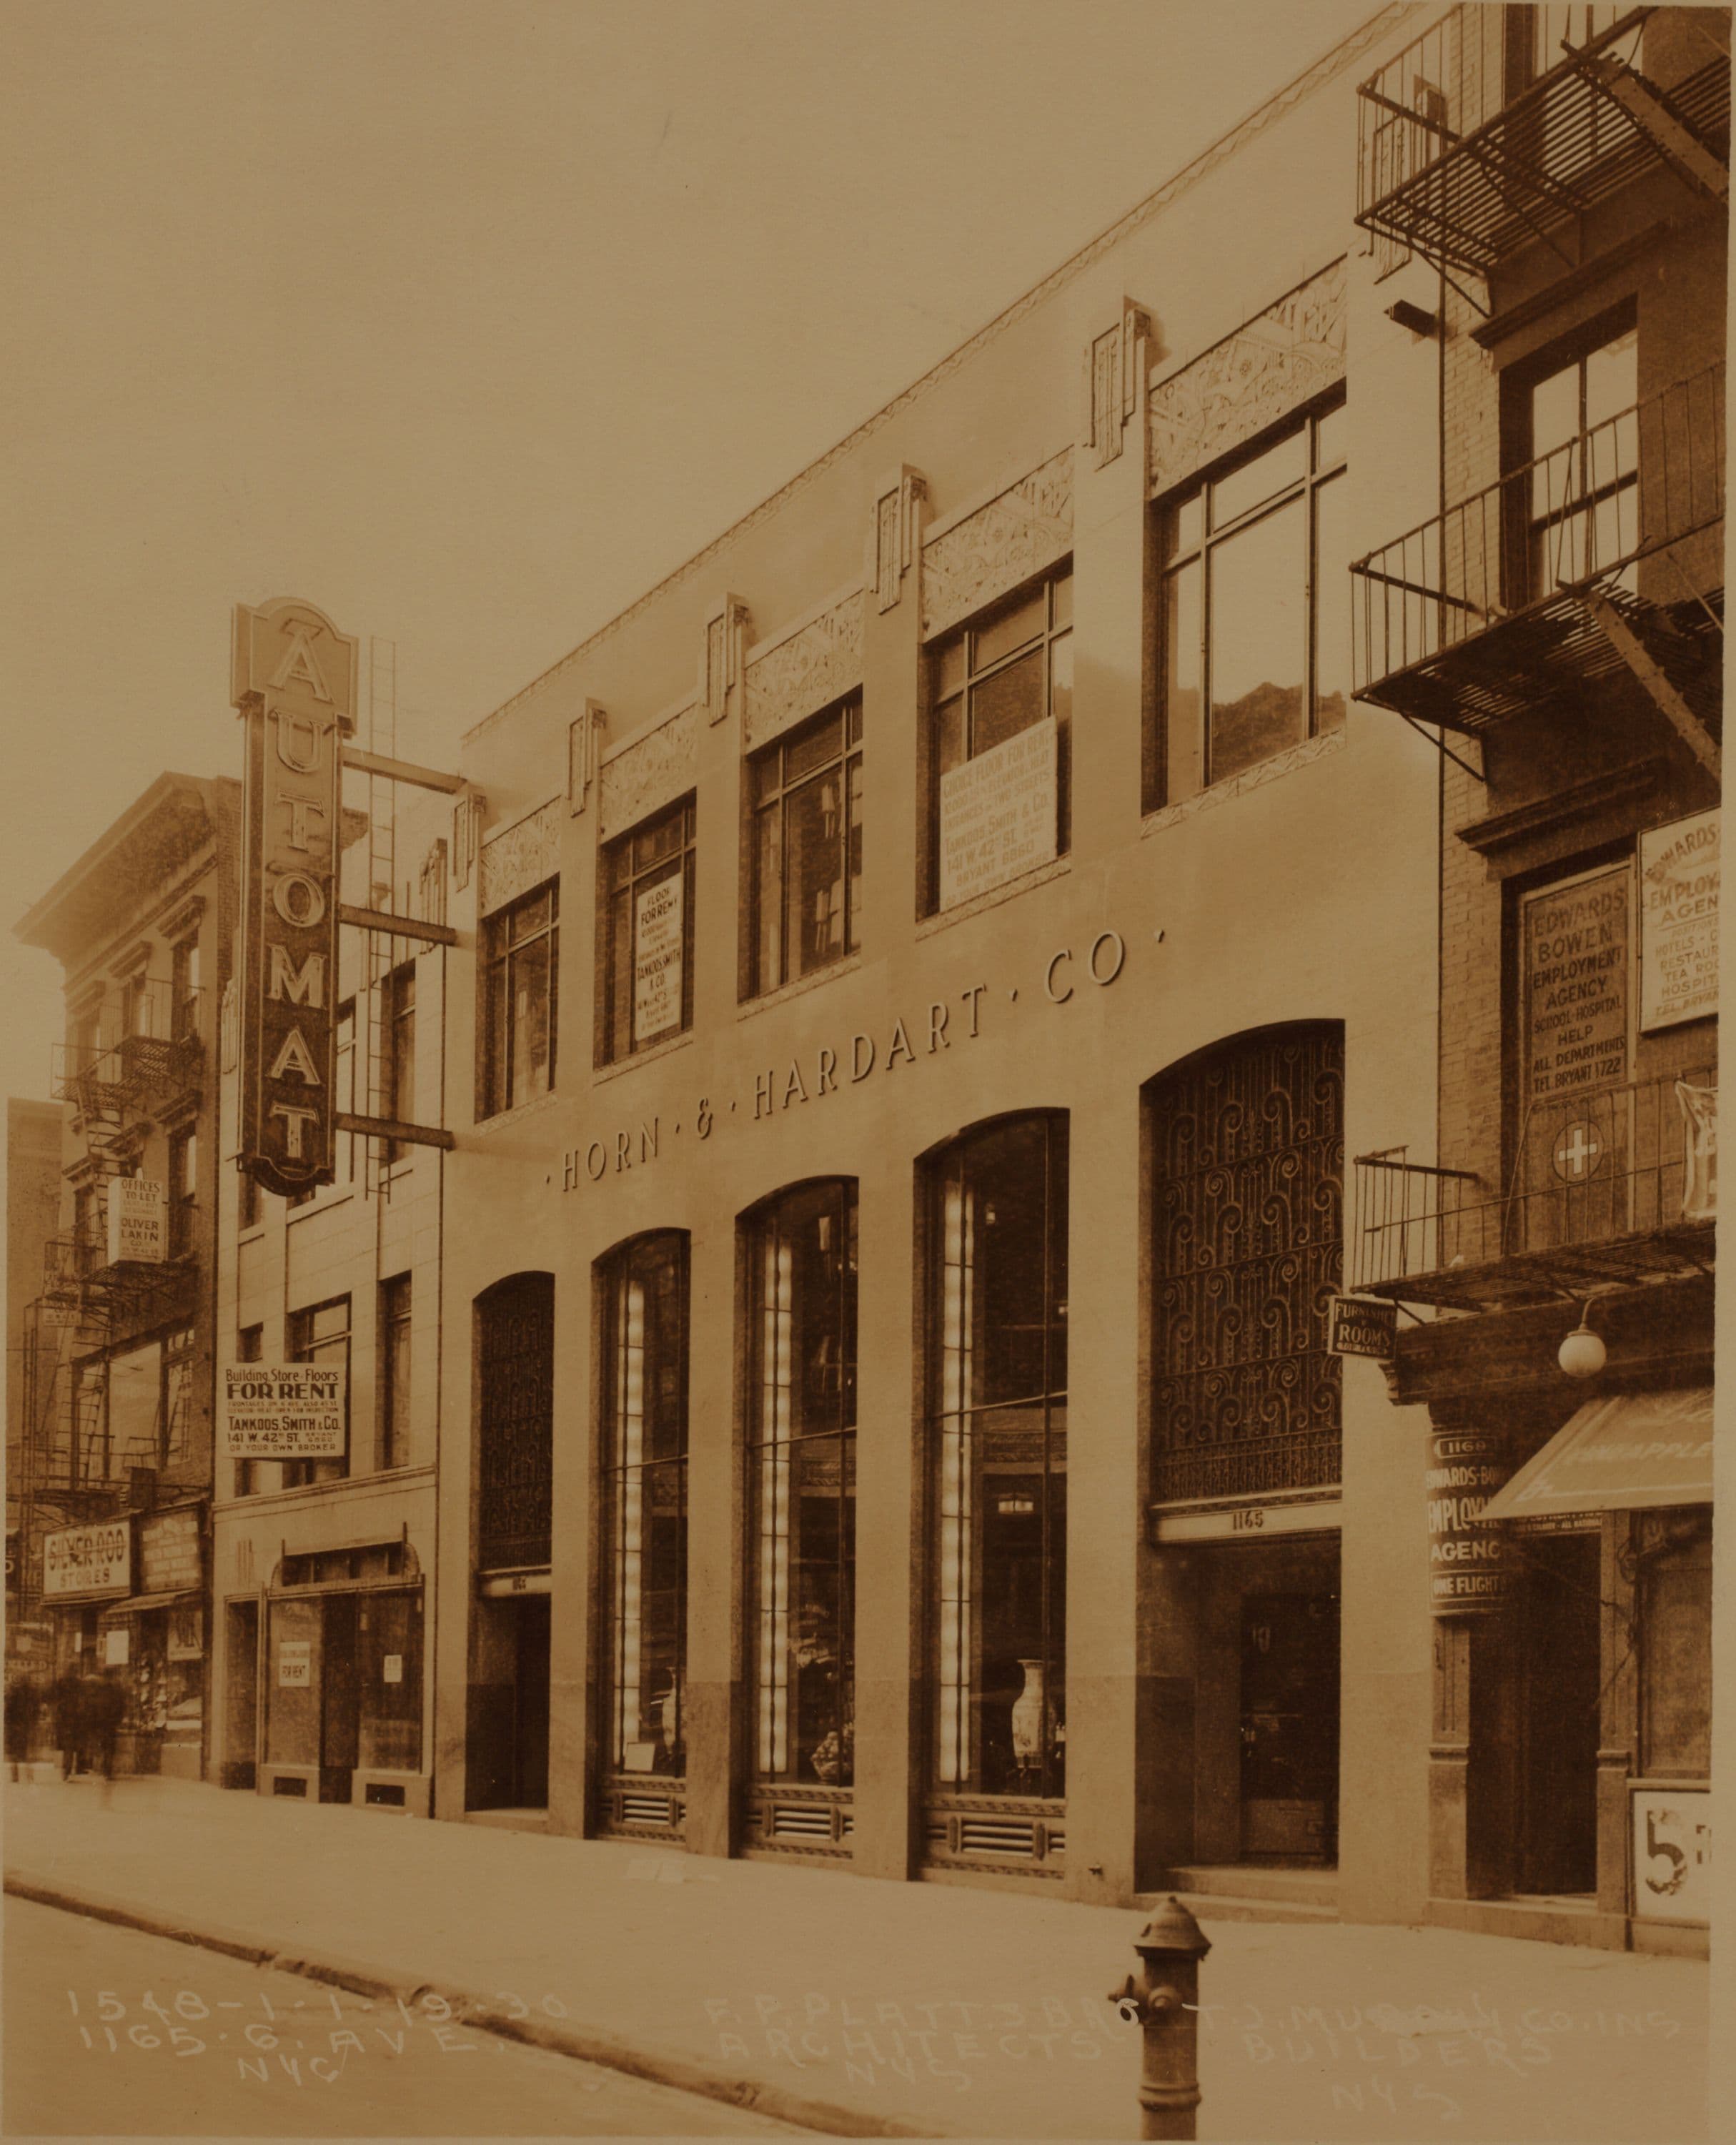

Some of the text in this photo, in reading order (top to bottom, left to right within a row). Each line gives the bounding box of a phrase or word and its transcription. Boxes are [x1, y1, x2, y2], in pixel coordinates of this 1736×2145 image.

[266, 618, 335, 1159] AUTOMAT
[1534, 888, 1625, 938] EDWARDS
[1537, 919, 1613, 963] BOWEN
[1533, 945, 1624, 989] EMPLOYMENT
[1664, 968, 1688, 984] TEA
[1545, 974, 1608, 1011] AGENCY
[1576, 994, 1622, 1021] HOSPITAL
[1557, 1024, 1594, 1046] HELP
[1533, 1034, 1626, 1074] ALL DEPARTMENTS
[1554, 1063, 1593, 1090] BRYANT
[1594, 1056, 1621, 1080] 1722
[562, 1116, 659, 1192] HORN
[695, 1096, 714, 1140] &
[752, 982, 988, 1120] HARDART
[121, 1179, 161, 1193] OFFICES
[121, 1217, 159, 1231] OLIVER
[1339, 1323, 1391, 1347] ROOMS
[305, 1368, 339, 1382] Floors
[227, 1383, 339, 1400] FOR RENT
[282, 1415, 316, 1431] SMITH
[228, 1432, 244, 1443] 141
[1232, 1510, 1264, 1530] 1165
[60, 1567, 110, 1587] STORES
[1433, 1577, 1454, 1595] ONE
